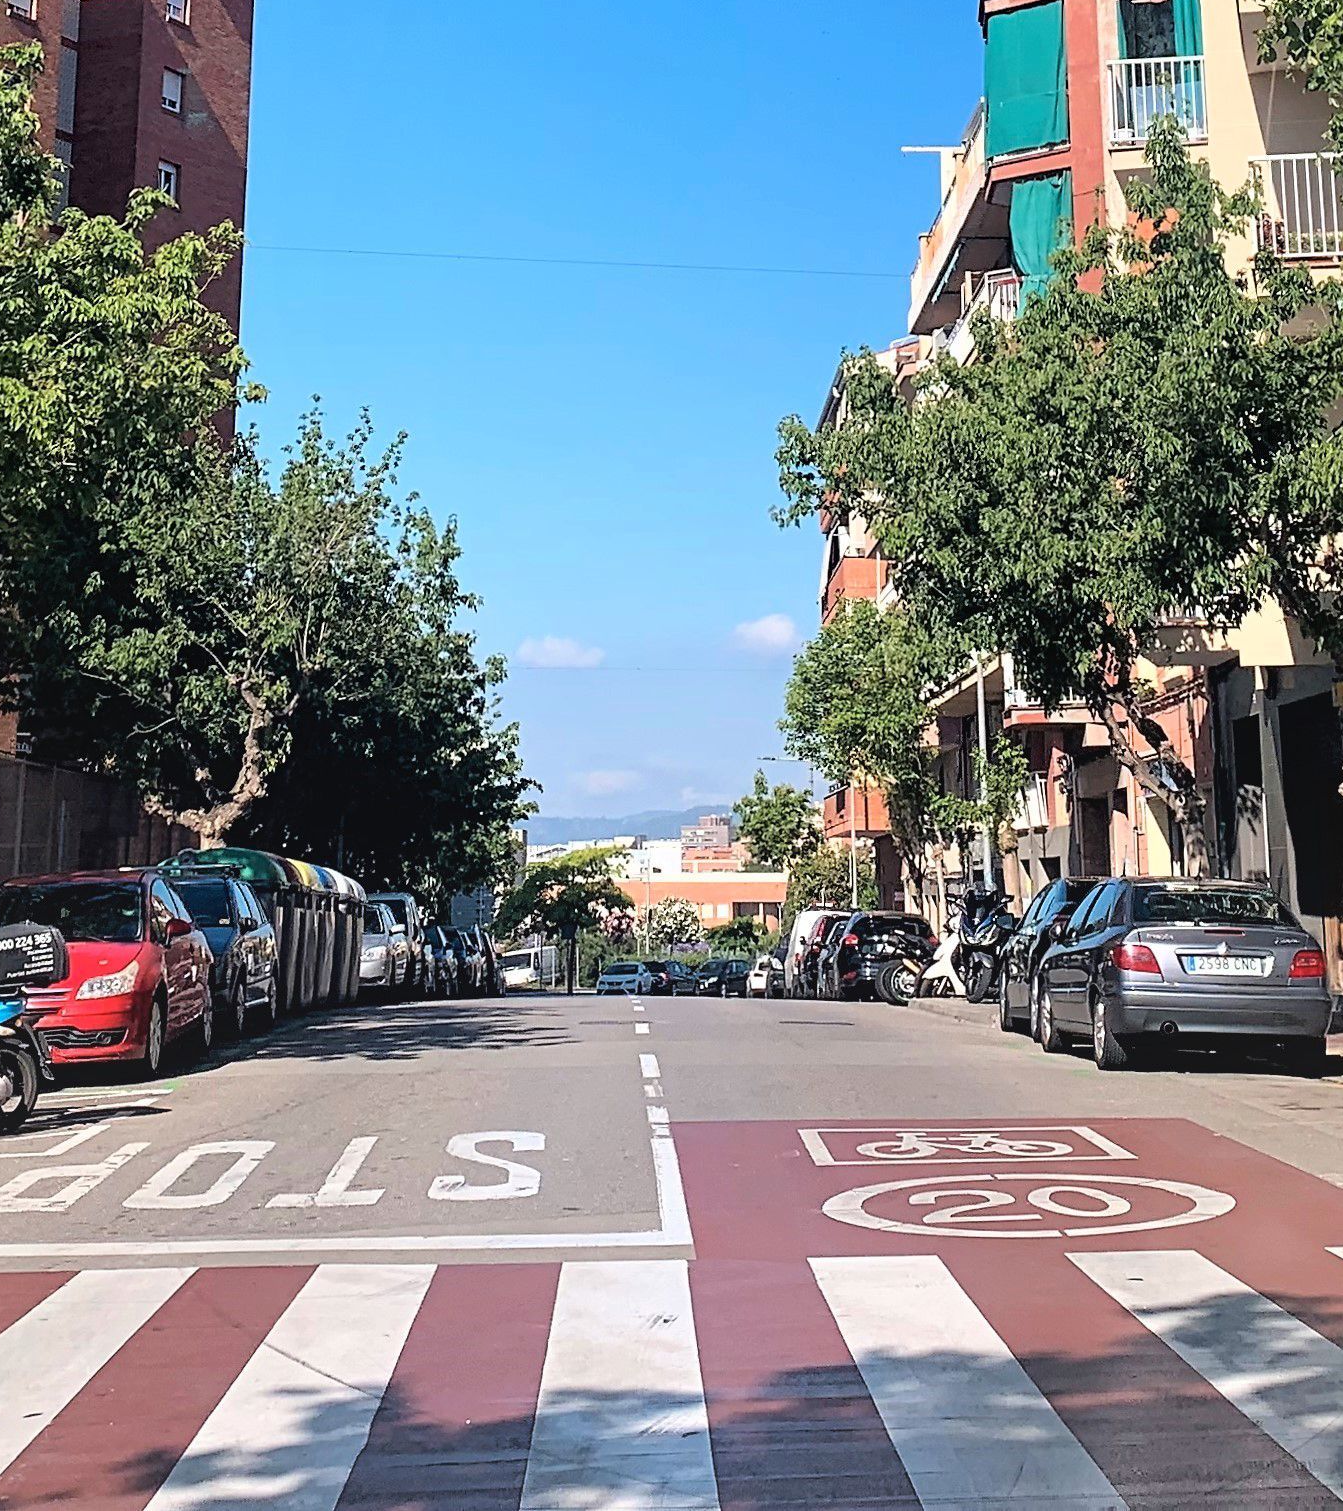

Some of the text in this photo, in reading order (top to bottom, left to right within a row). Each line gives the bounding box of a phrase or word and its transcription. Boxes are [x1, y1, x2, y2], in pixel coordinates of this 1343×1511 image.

[15, 935, 33, 948] 224
[34, 931, 52, 945] 365
[1198, 956, 1257, 971] 2598 CNC
[908, 1186, 1131, 1224] 20
